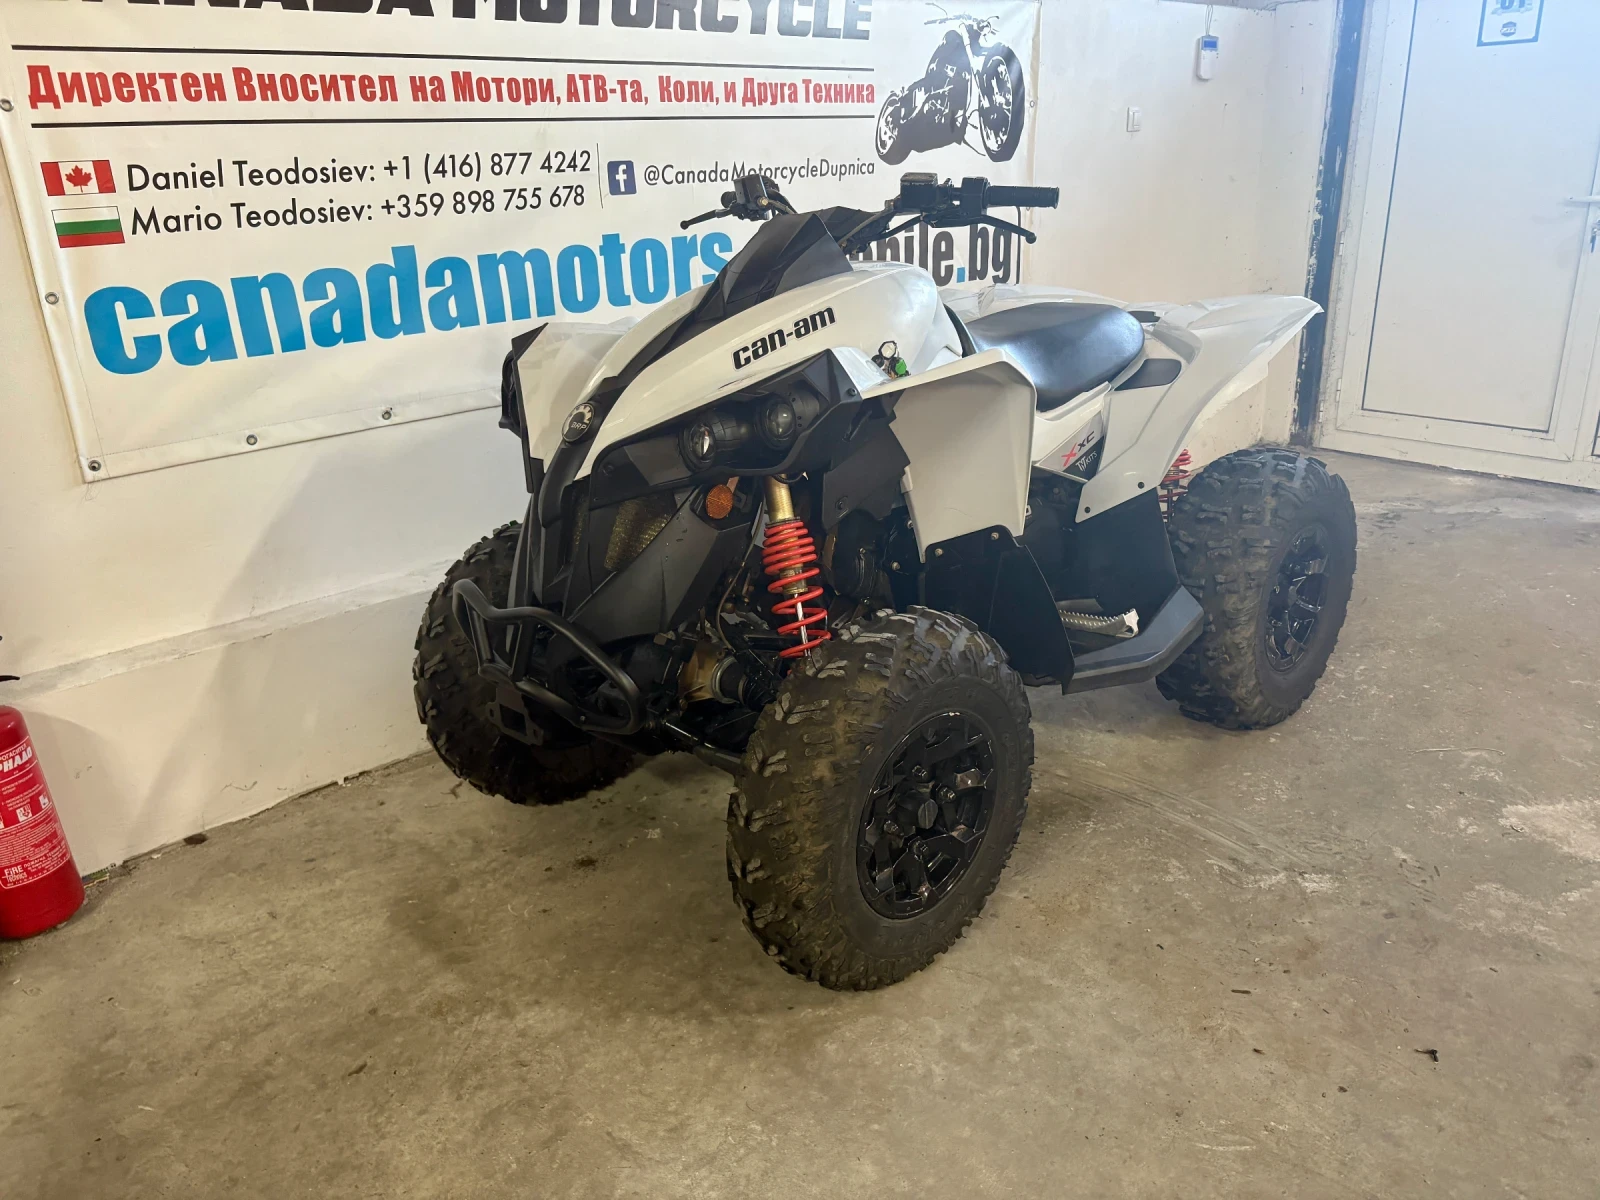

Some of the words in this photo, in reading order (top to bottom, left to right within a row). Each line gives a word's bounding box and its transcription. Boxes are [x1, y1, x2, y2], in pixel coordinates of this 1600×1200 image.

[27, 65, 228, 109] Директен
[232, 67, 398, 102] Вносител
[409, 75, 446, 102] на
[451, 71, 561, 106] Мотори,
[566, 74, 648, 105] АТВ-та,
[658, 75, 719, 105] Коли,
[724, 81, 737, 103] и
[742, 77, 798, 107] Друга
[802, 78, 875, 103] Техника
[127, 158, 224, 191] Daniel
[232, 156, 376, 187] Teodosiev:
[384, 155, 411, 180] +1
[424, 152, 481, 184] (416)
[490, 152, 532, 176] 877
[540, 150, 591, 173] 4242
[131, 204, 222, 235] Mario
[230, 197, 373, 229] Teodosiev:
[381, 192, 444, 218] +359
[453, 189, 495, 214] 898
[503, 186, 542, 211] 755
[549, 184, 585, 208] 678
[732, 306, 836, 370] can-am
[570, 421, 587, 430] BRP
[0, 746, 33, 773] НАДО
